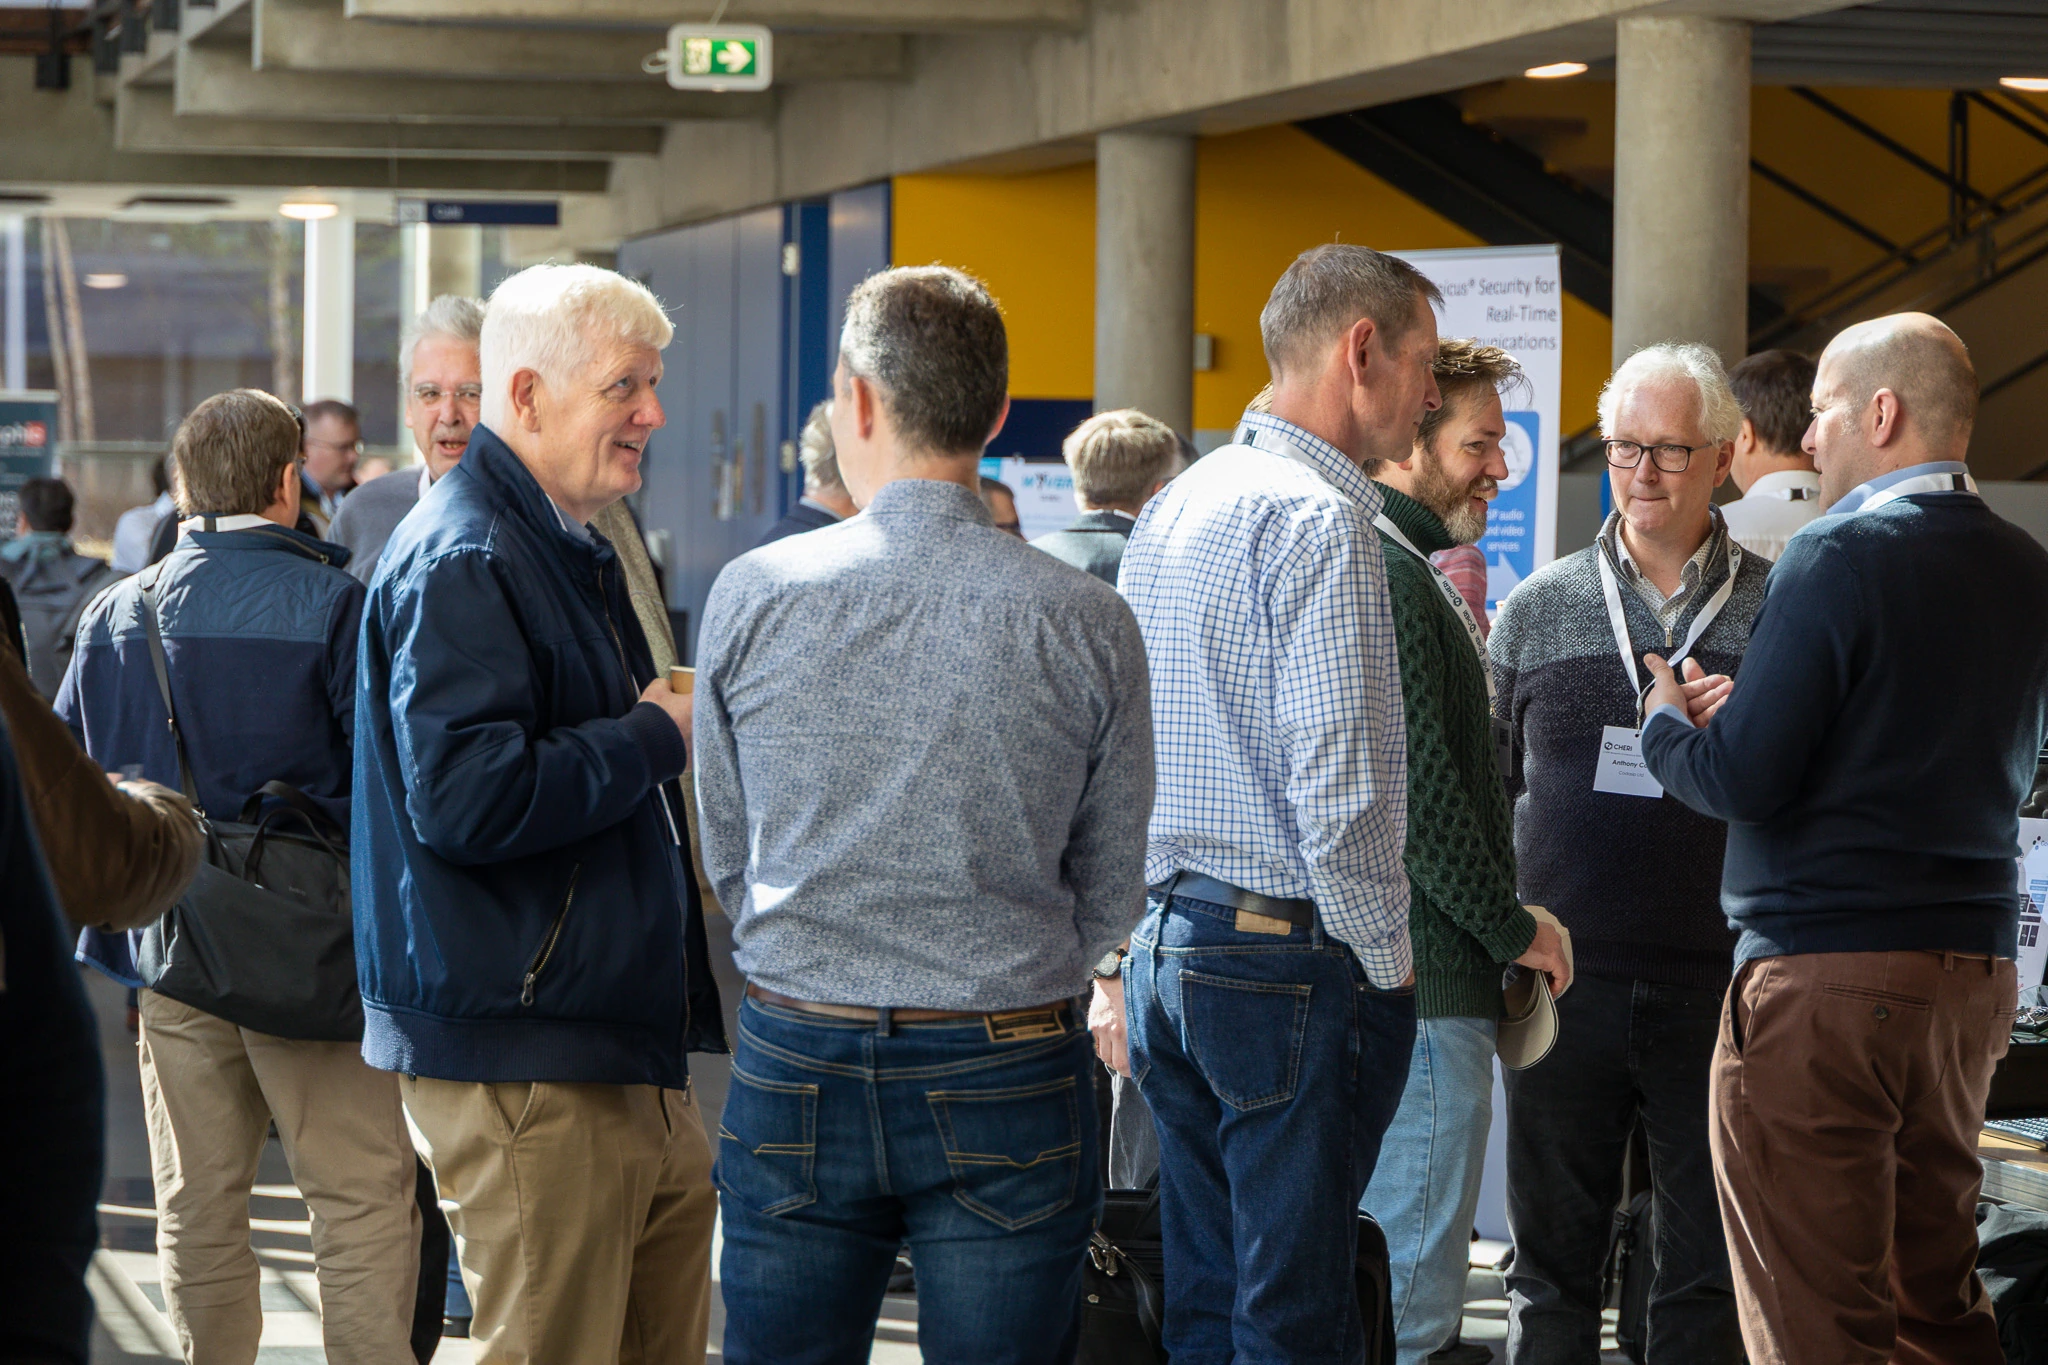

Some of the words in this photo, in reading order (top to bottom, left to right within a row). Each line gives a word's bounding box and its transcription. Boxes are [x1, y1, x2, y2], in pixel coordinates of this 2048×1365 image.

[1478, 278, 1532, 298] Security
[1535, 276, 1556, 294] for
[1486, 305, 1557, 322] Real-Time
[1499, 509, 1525, 521] audio
[1500, 525, 1526, 537] video
[1486, 541, 1521, 553] services
[1442, 580, 1457, 599] CHERI
[1463, 609, 1473, 626] CHERI
[1612, 760, 1638, 768] Anthony
